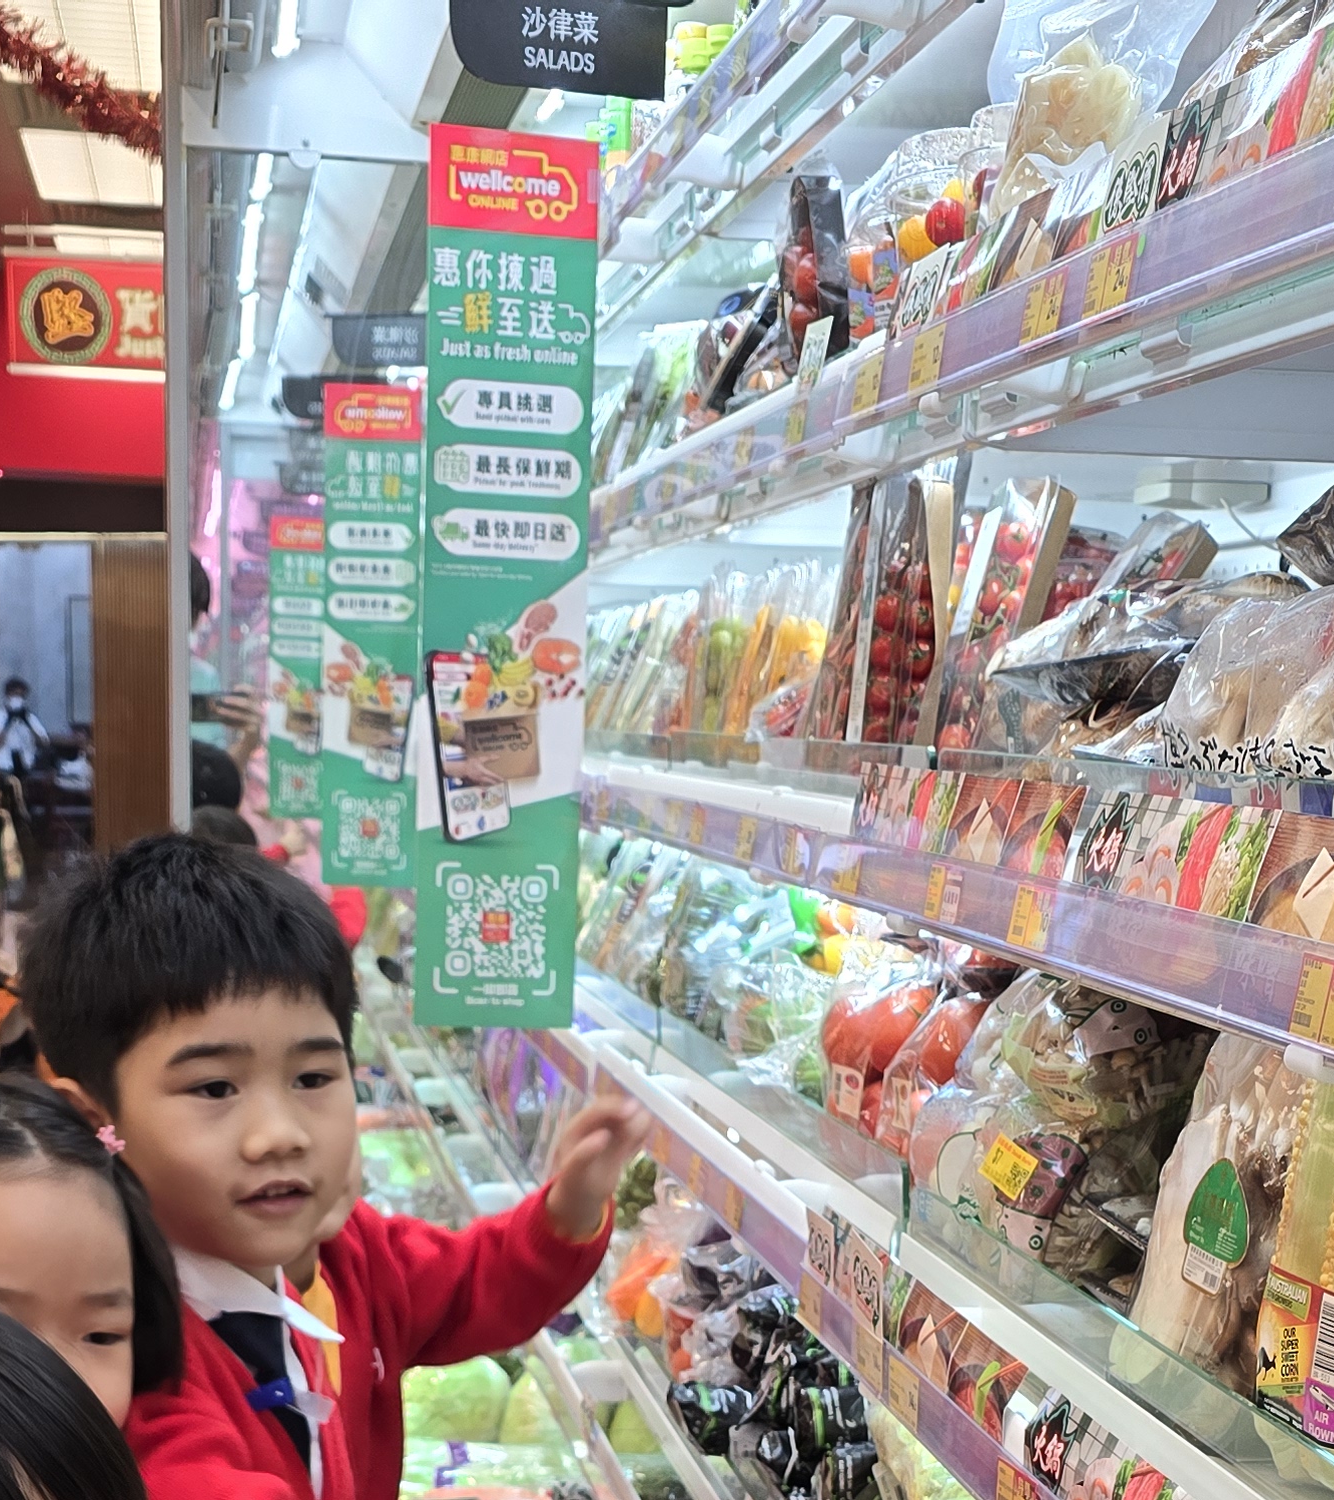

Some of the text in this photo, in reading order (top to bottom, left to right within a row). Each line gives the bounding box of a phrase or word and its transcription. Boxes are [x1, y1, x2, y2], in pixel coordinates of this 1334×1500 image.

[522, 6, 599, 44] 沙律菜
[523, 46, 595, 75] SALADS
[459, 168, 561, 196] wellcome
[1158, 139, 1201, 203] 火鍋
[467, 194, 519, 211] ONLINE
[433, 247, 558, 296] 惠你揀過
[463, 292, 557, 340] 鮮至送
[441, 338, 472, 358] Just
[474, 343, 491, 360] as
[493, 343, 531, 362] fresh
[533, 347, 579, 366] online
[1085, 826, 1123, 872] 火鍋
[1280, 1339, 1299, 1351] SUPER
[1282, 1328, 1297, 1338] OUR
[1280, 1351, 1299, 1363] SWEET
[1280, 1363, 1299, 1377] CORN
[1313, 1411, 1329, 1425] AIR
[1033, 1424, 1065, 1481] 火鍋
